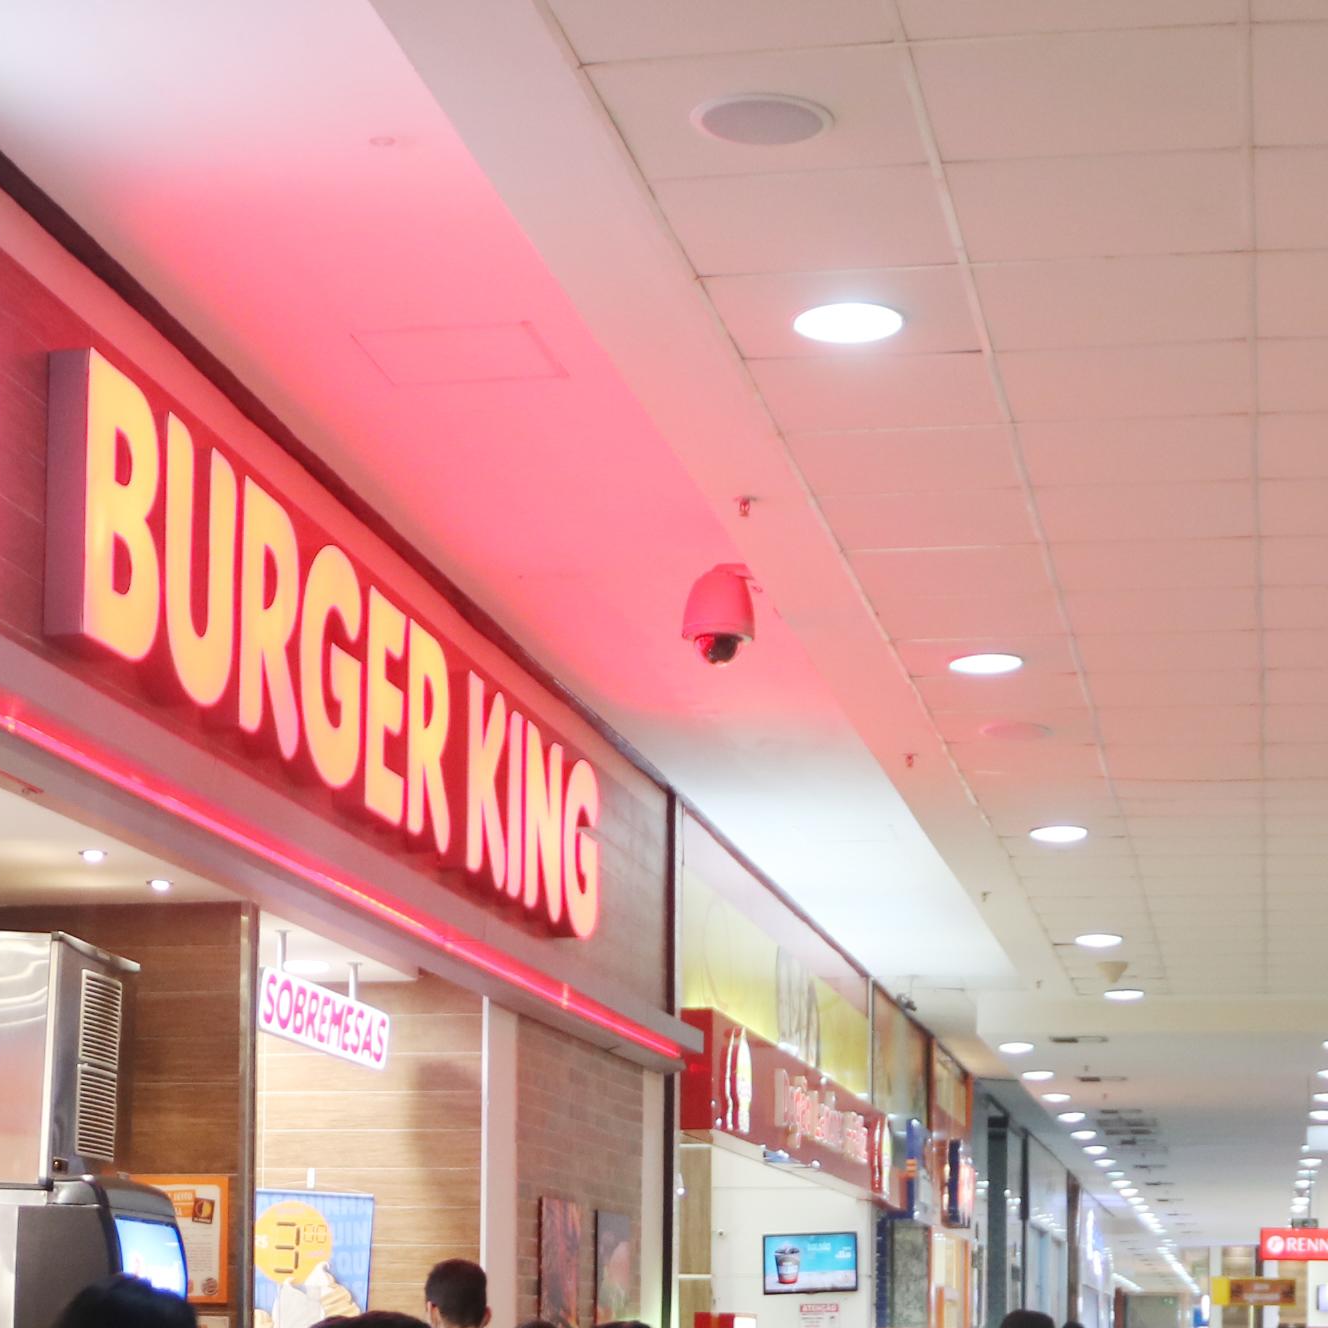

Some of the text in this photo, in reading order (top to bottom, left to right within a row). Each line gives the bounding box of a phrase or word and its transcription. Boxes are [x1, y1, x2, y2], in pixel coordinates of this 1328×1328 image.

[83, 347, 602, 942] BURGER KING
[263, 974, 387, 1063] SOBREMESAS
